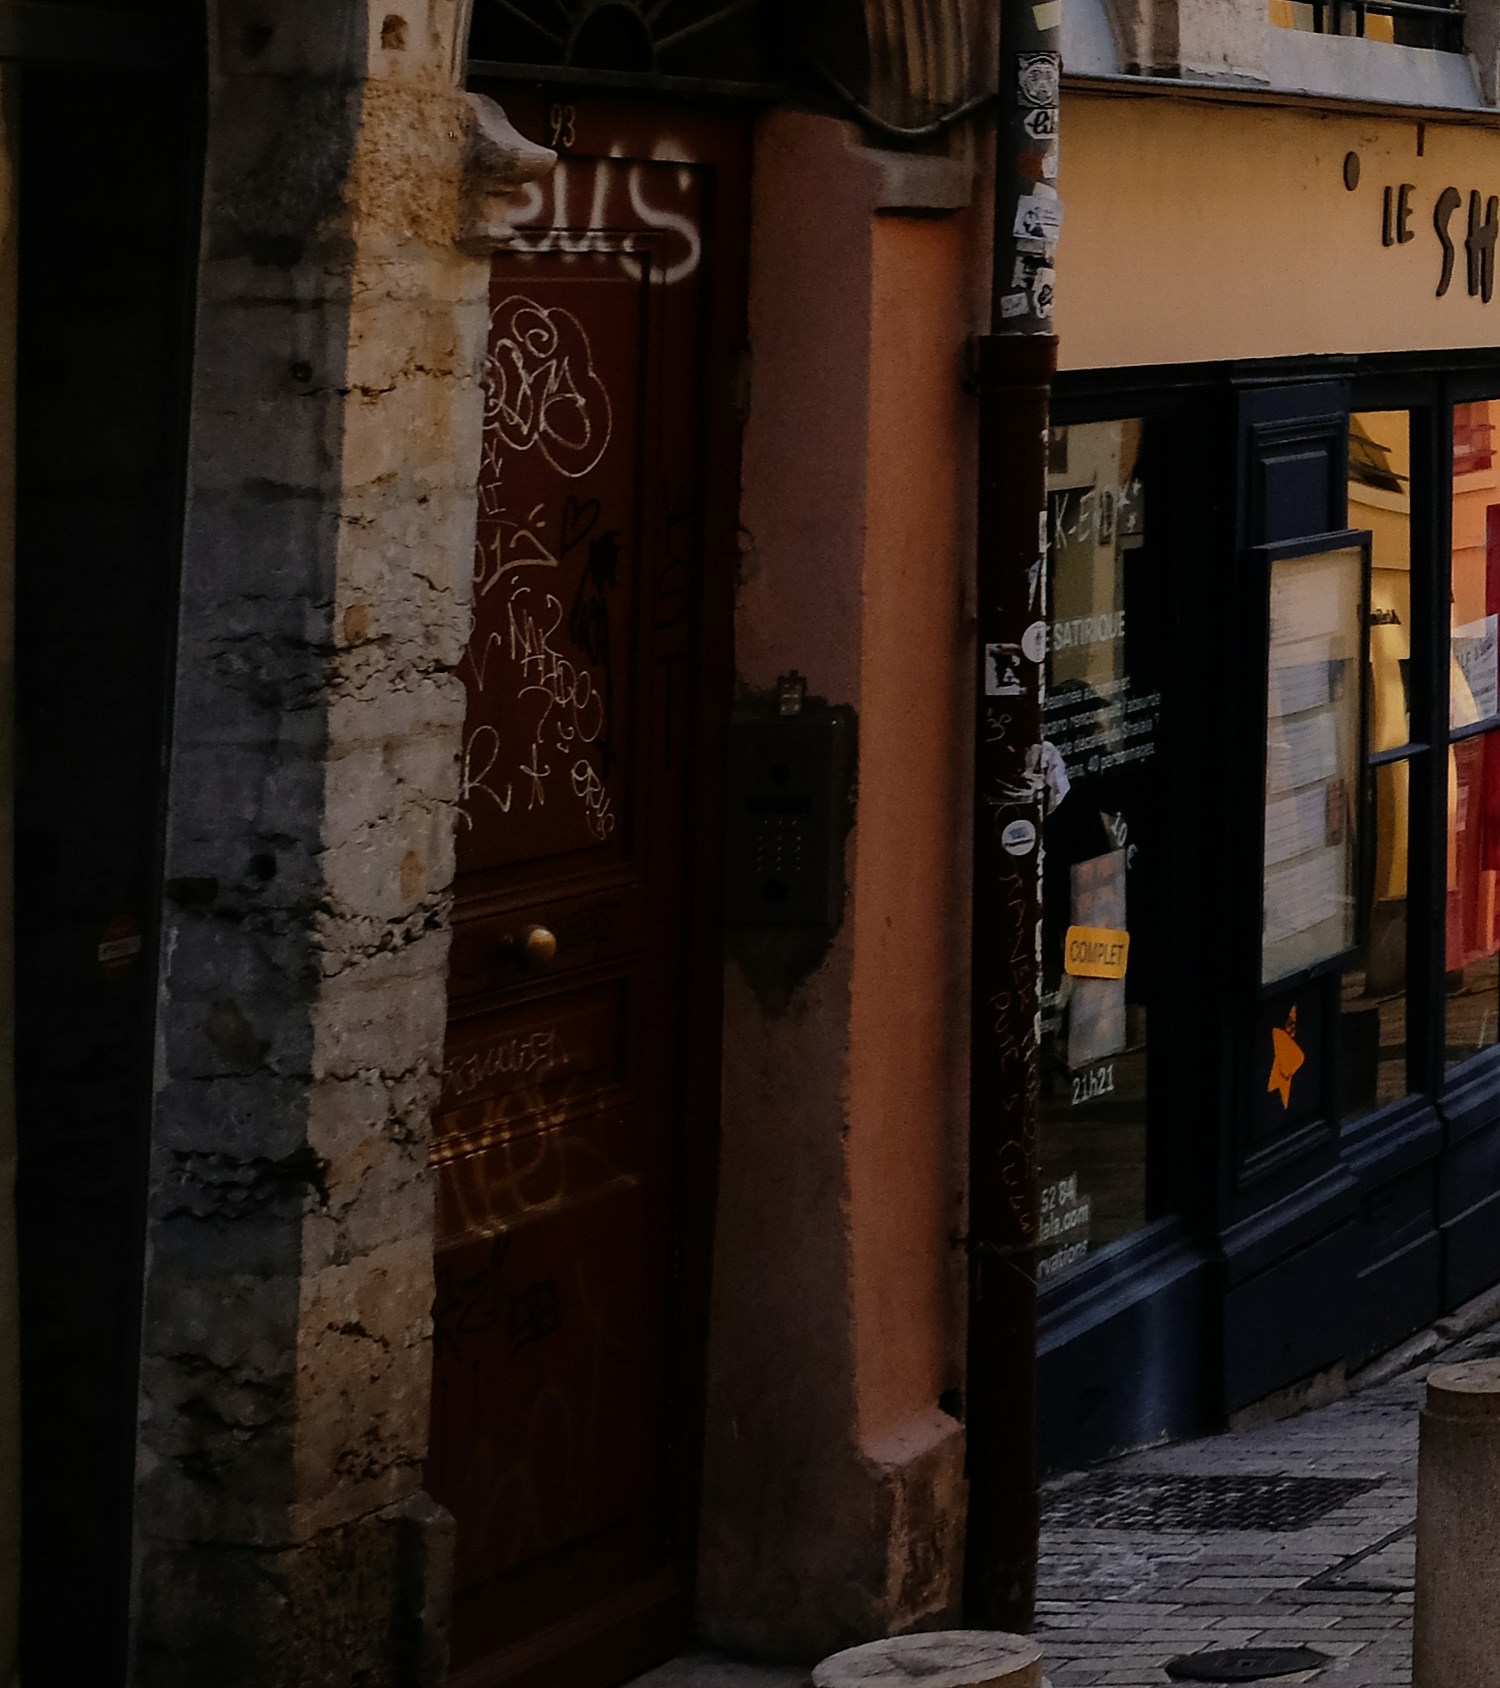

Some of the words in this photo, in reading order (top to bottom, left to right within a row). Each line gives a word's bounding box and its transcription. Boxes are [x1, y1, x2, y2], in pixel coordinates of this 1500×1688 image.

[549, 102, 577, 149] 93
[1381, 183, 1416, 248] LE
[1070, 939, 1124, 965] COMPLET
[1072, 1064, 1115, 1107] 21h21
